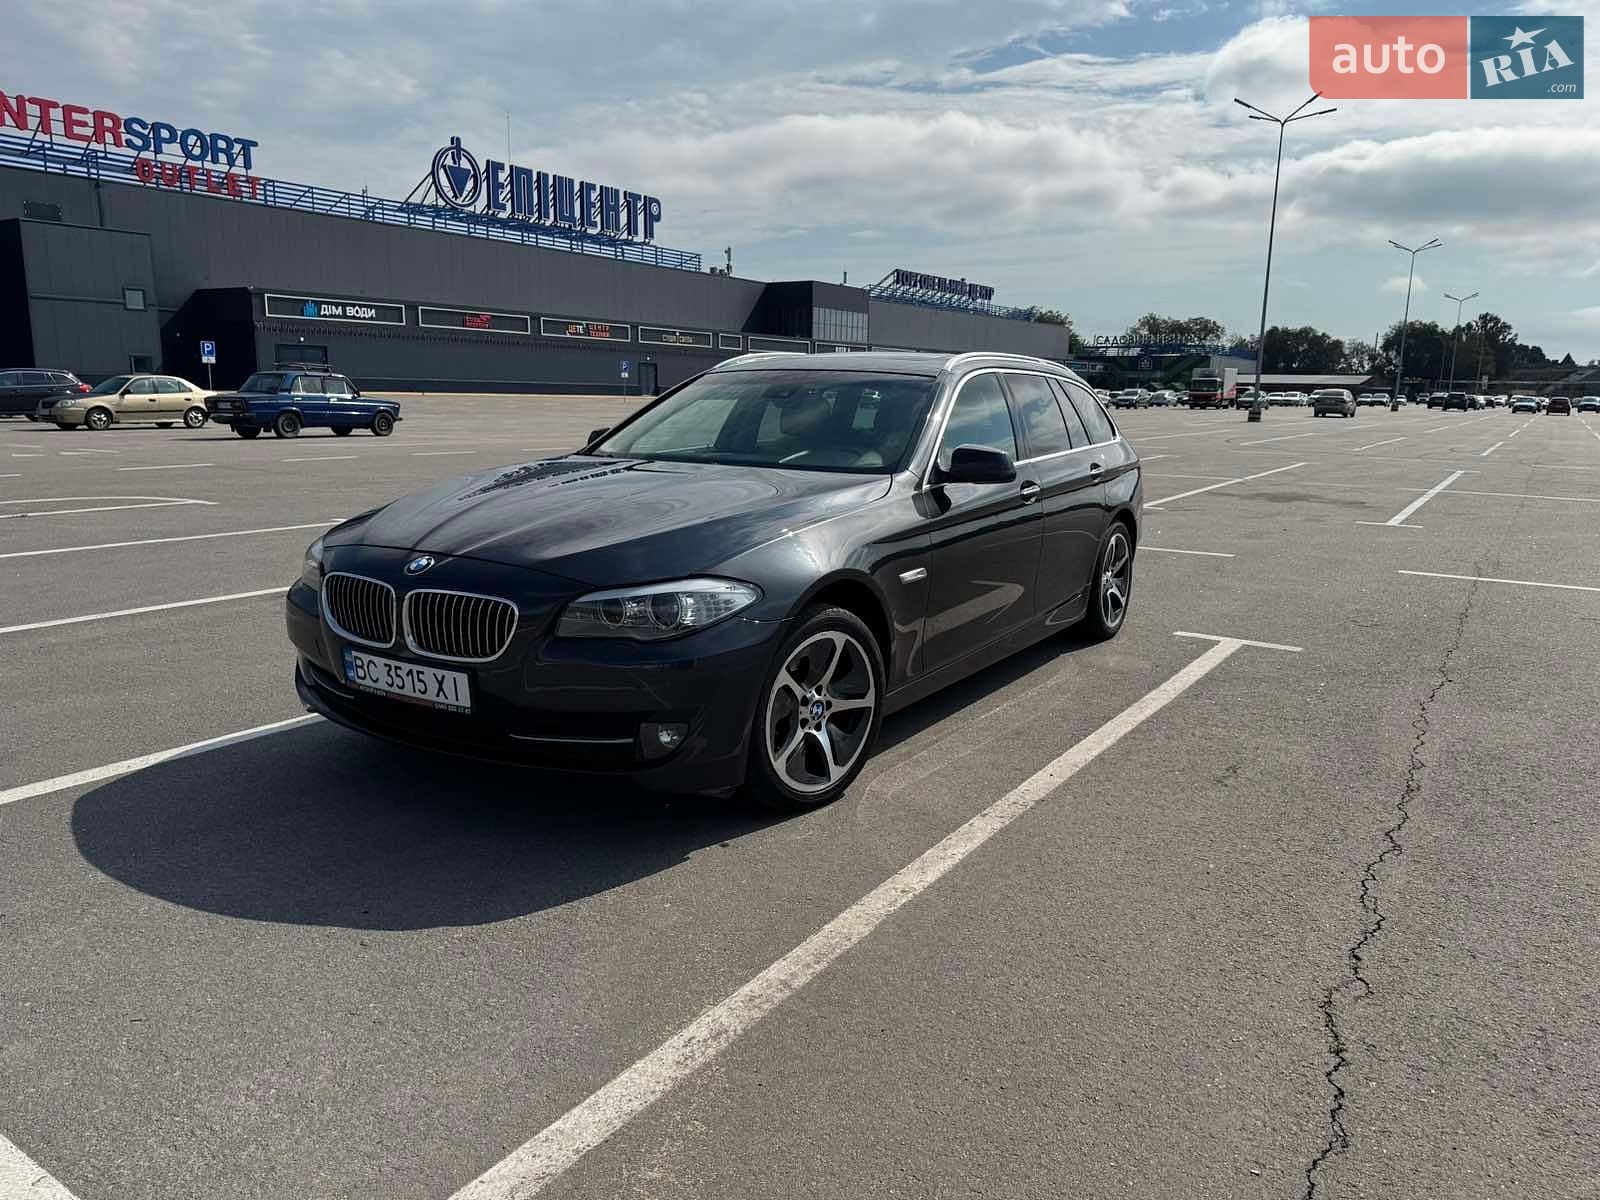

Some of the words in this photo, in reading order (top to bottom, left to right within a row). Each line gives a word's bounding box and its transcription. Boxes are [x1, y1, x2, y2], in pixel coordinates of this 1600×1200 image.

[135, 158, 261, 200] OUTLET
[485, 159, 662, 240] ЕПІЦЕНТР
[320, 304, 343, 316] ДІМ
[346, 305, 376, 319] ВОДИ
[204, 343, 213, 354] P
[354, 655, 380, 684] BC
[383, 663, 428, 696] 3515
[432, 672, 460, 702] XI
